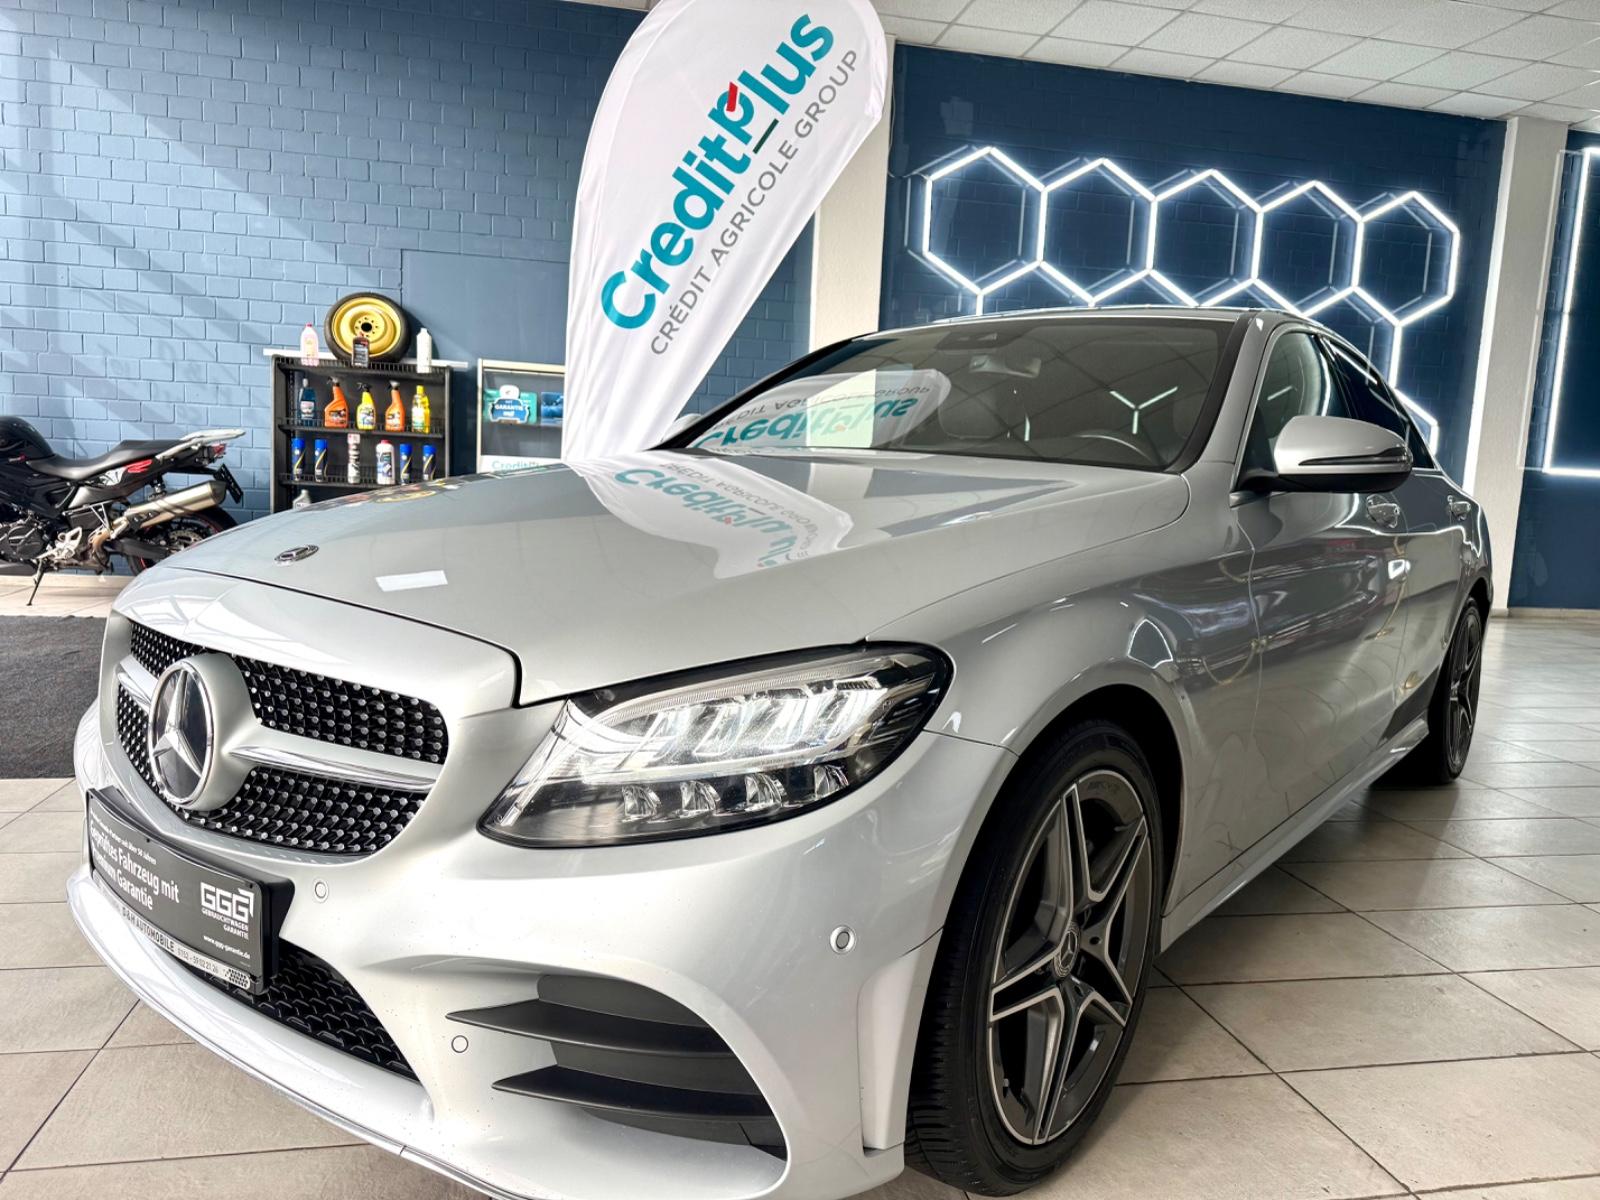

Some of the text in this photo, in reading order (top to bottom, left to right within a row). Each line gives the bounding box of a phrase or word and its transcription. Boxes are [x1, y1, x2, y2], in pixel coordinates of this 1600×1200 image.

[650, 50, 858, 355] CRÉDIT AGRICOLE GROUP
[117, 868, 154, 911] Garantie
[119, 847, 159, 896] Fahrzeug
[161, 880, 180, 903] mit
[200, 881, 249, 924] GGG
[136, 920, 175, 953] AUTOMOBILE
